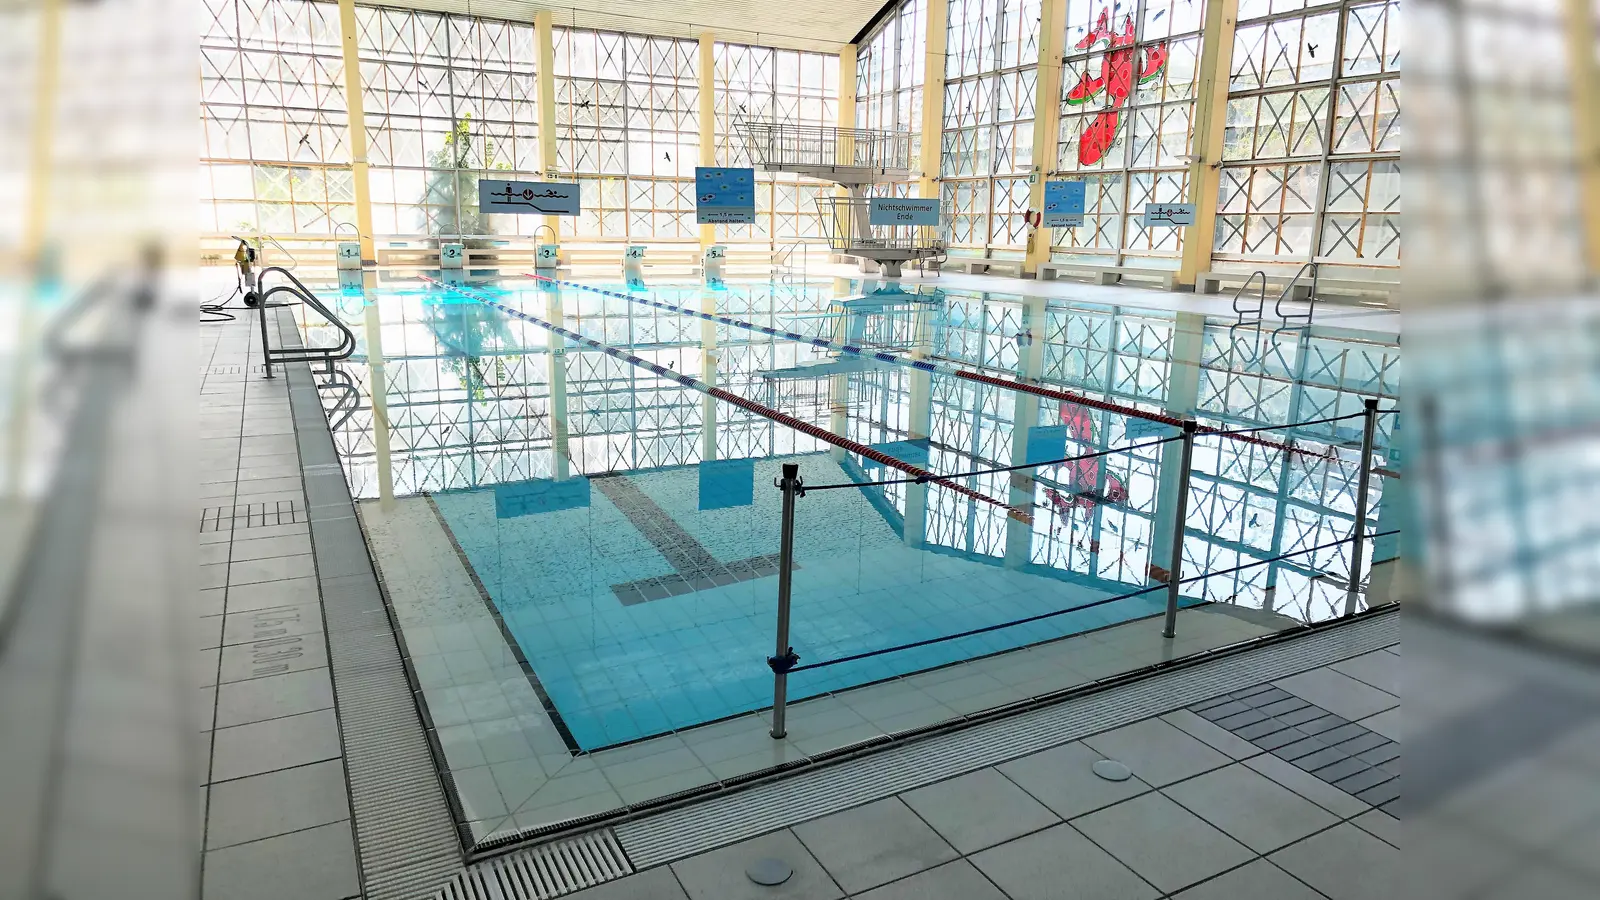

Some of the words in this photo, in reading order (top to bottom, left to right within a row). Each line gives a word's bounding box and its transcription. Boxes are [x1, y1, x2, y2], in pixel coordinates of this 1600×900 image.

[877, 203, 933, 212] Nichtschwimmer
[896, 212, 914, 220] Ende
[345, 248, 351, 258] 1
[449, 249, 455, 258] 2
[544, 249, 550, 258] 3
[631, 250, 638, 259] 4
[711, 250, 717, 259] 5
